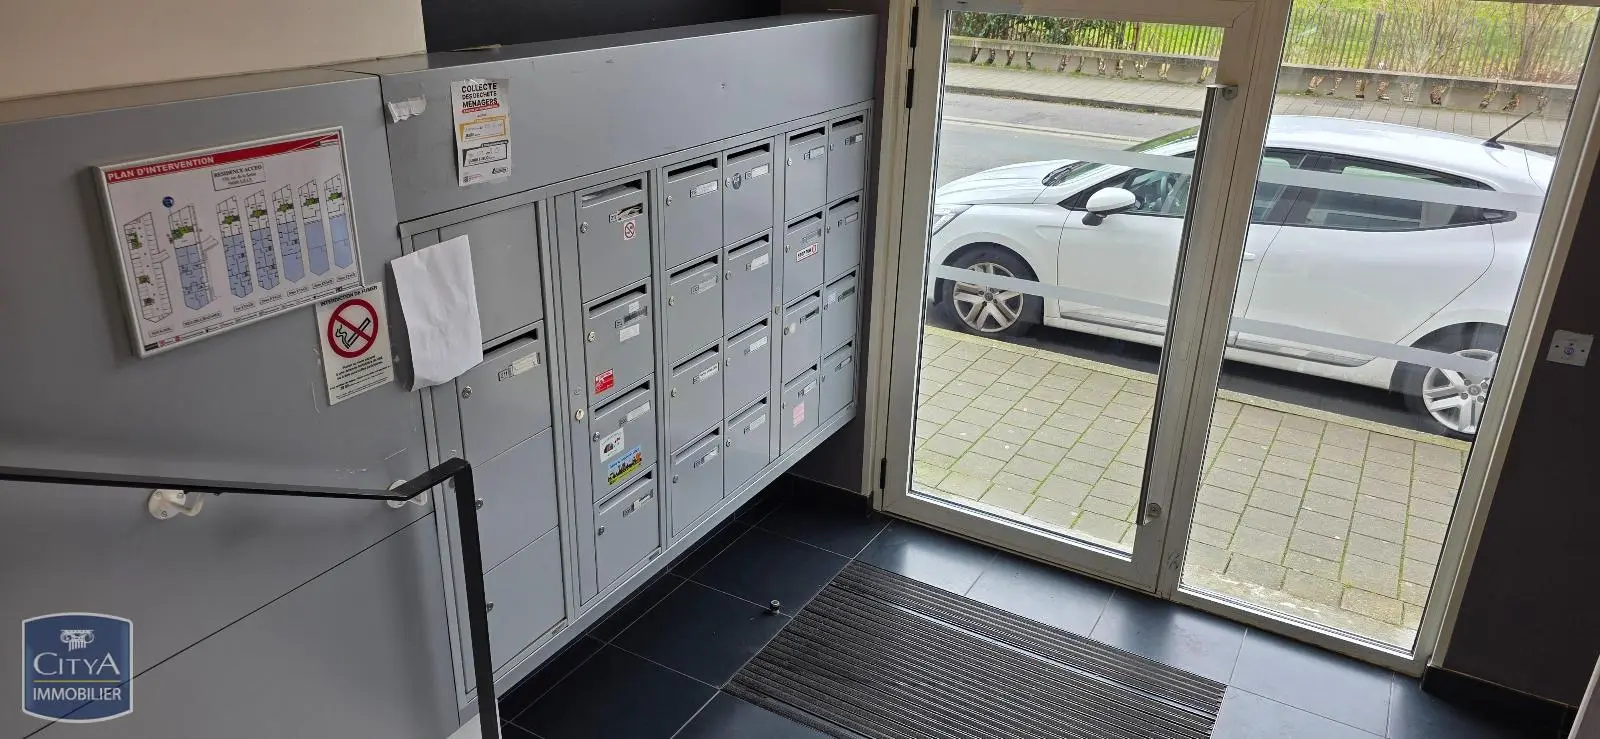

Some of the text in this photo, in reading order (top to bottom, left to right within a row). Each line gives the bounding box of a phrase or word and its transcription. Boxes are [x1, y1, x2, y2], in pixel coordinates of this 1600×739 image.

[461, 82, 497, 93] COLLECTE
[462, 98, 498, 108] MENAGERS
[107, 170, 135, 181] PLAN
[137, 156, 215, 176] D'INTERVENTION
